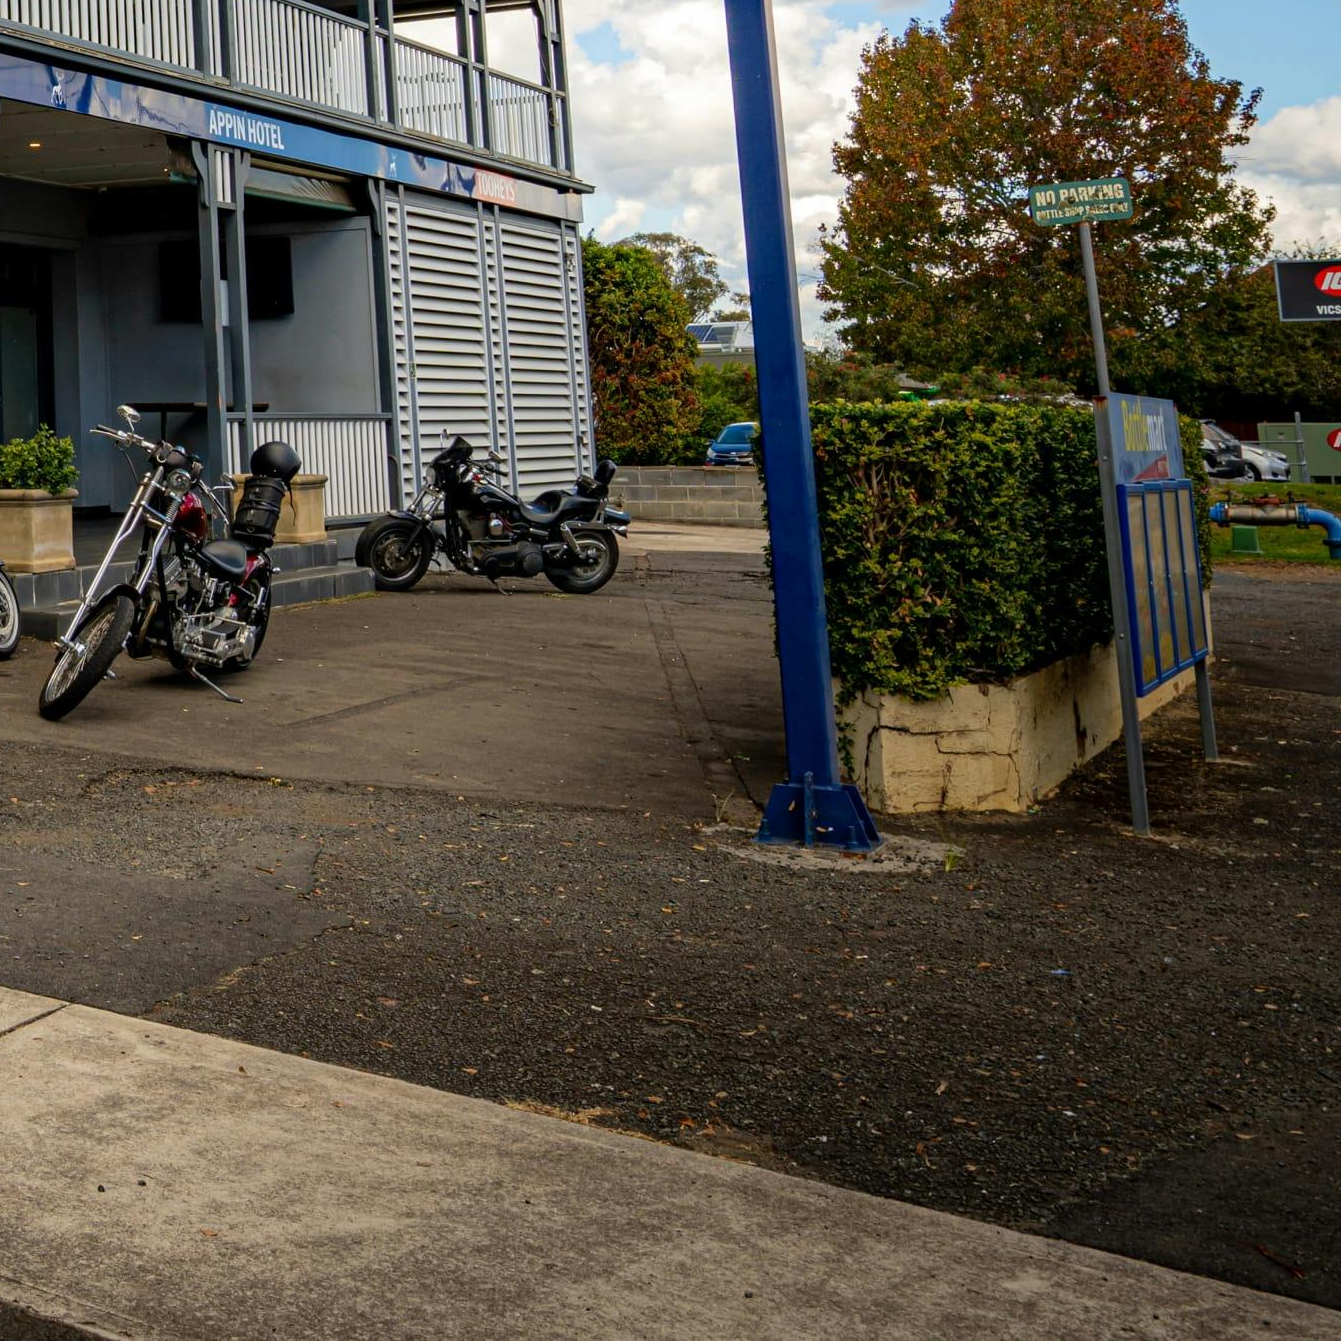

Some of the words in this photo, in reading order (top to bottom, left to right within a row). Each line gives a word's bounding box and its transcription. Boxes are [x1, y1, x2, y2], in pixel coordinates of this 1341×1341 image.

[209, 109, 246, 141] APPIN
[247, 118, 285, 150] HOTEL
[476, 171, 515, 202] TOOHEYS
[1035, 190, 1056, 207] NO
[1059, 183, 1125, 203] PARKING
[1064, 205, 1084, 217] SHOP
